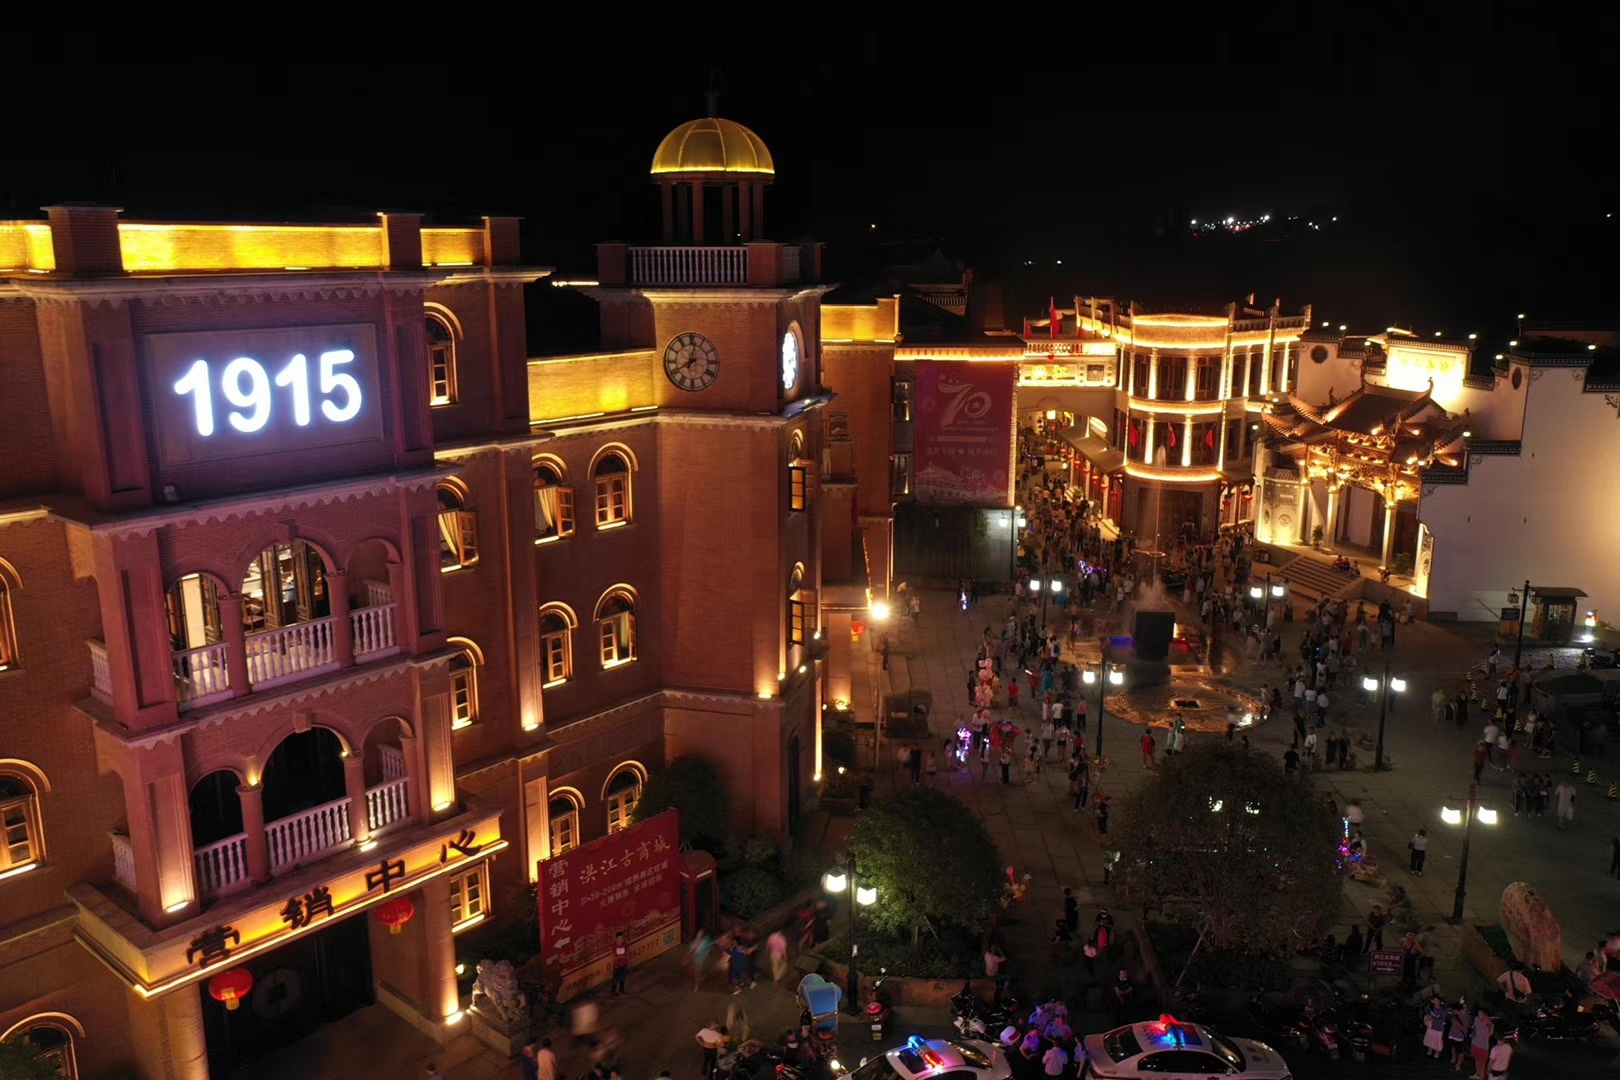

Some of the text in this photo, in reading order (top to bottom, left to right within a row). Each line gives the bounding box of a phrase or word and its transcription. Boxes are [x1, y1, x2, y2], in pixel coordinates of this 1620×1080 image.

[174, 349, 363, 437] 1915
[186, 829, 482, 968] 营销中心
[549, 859, 573, 937] 营销中心
